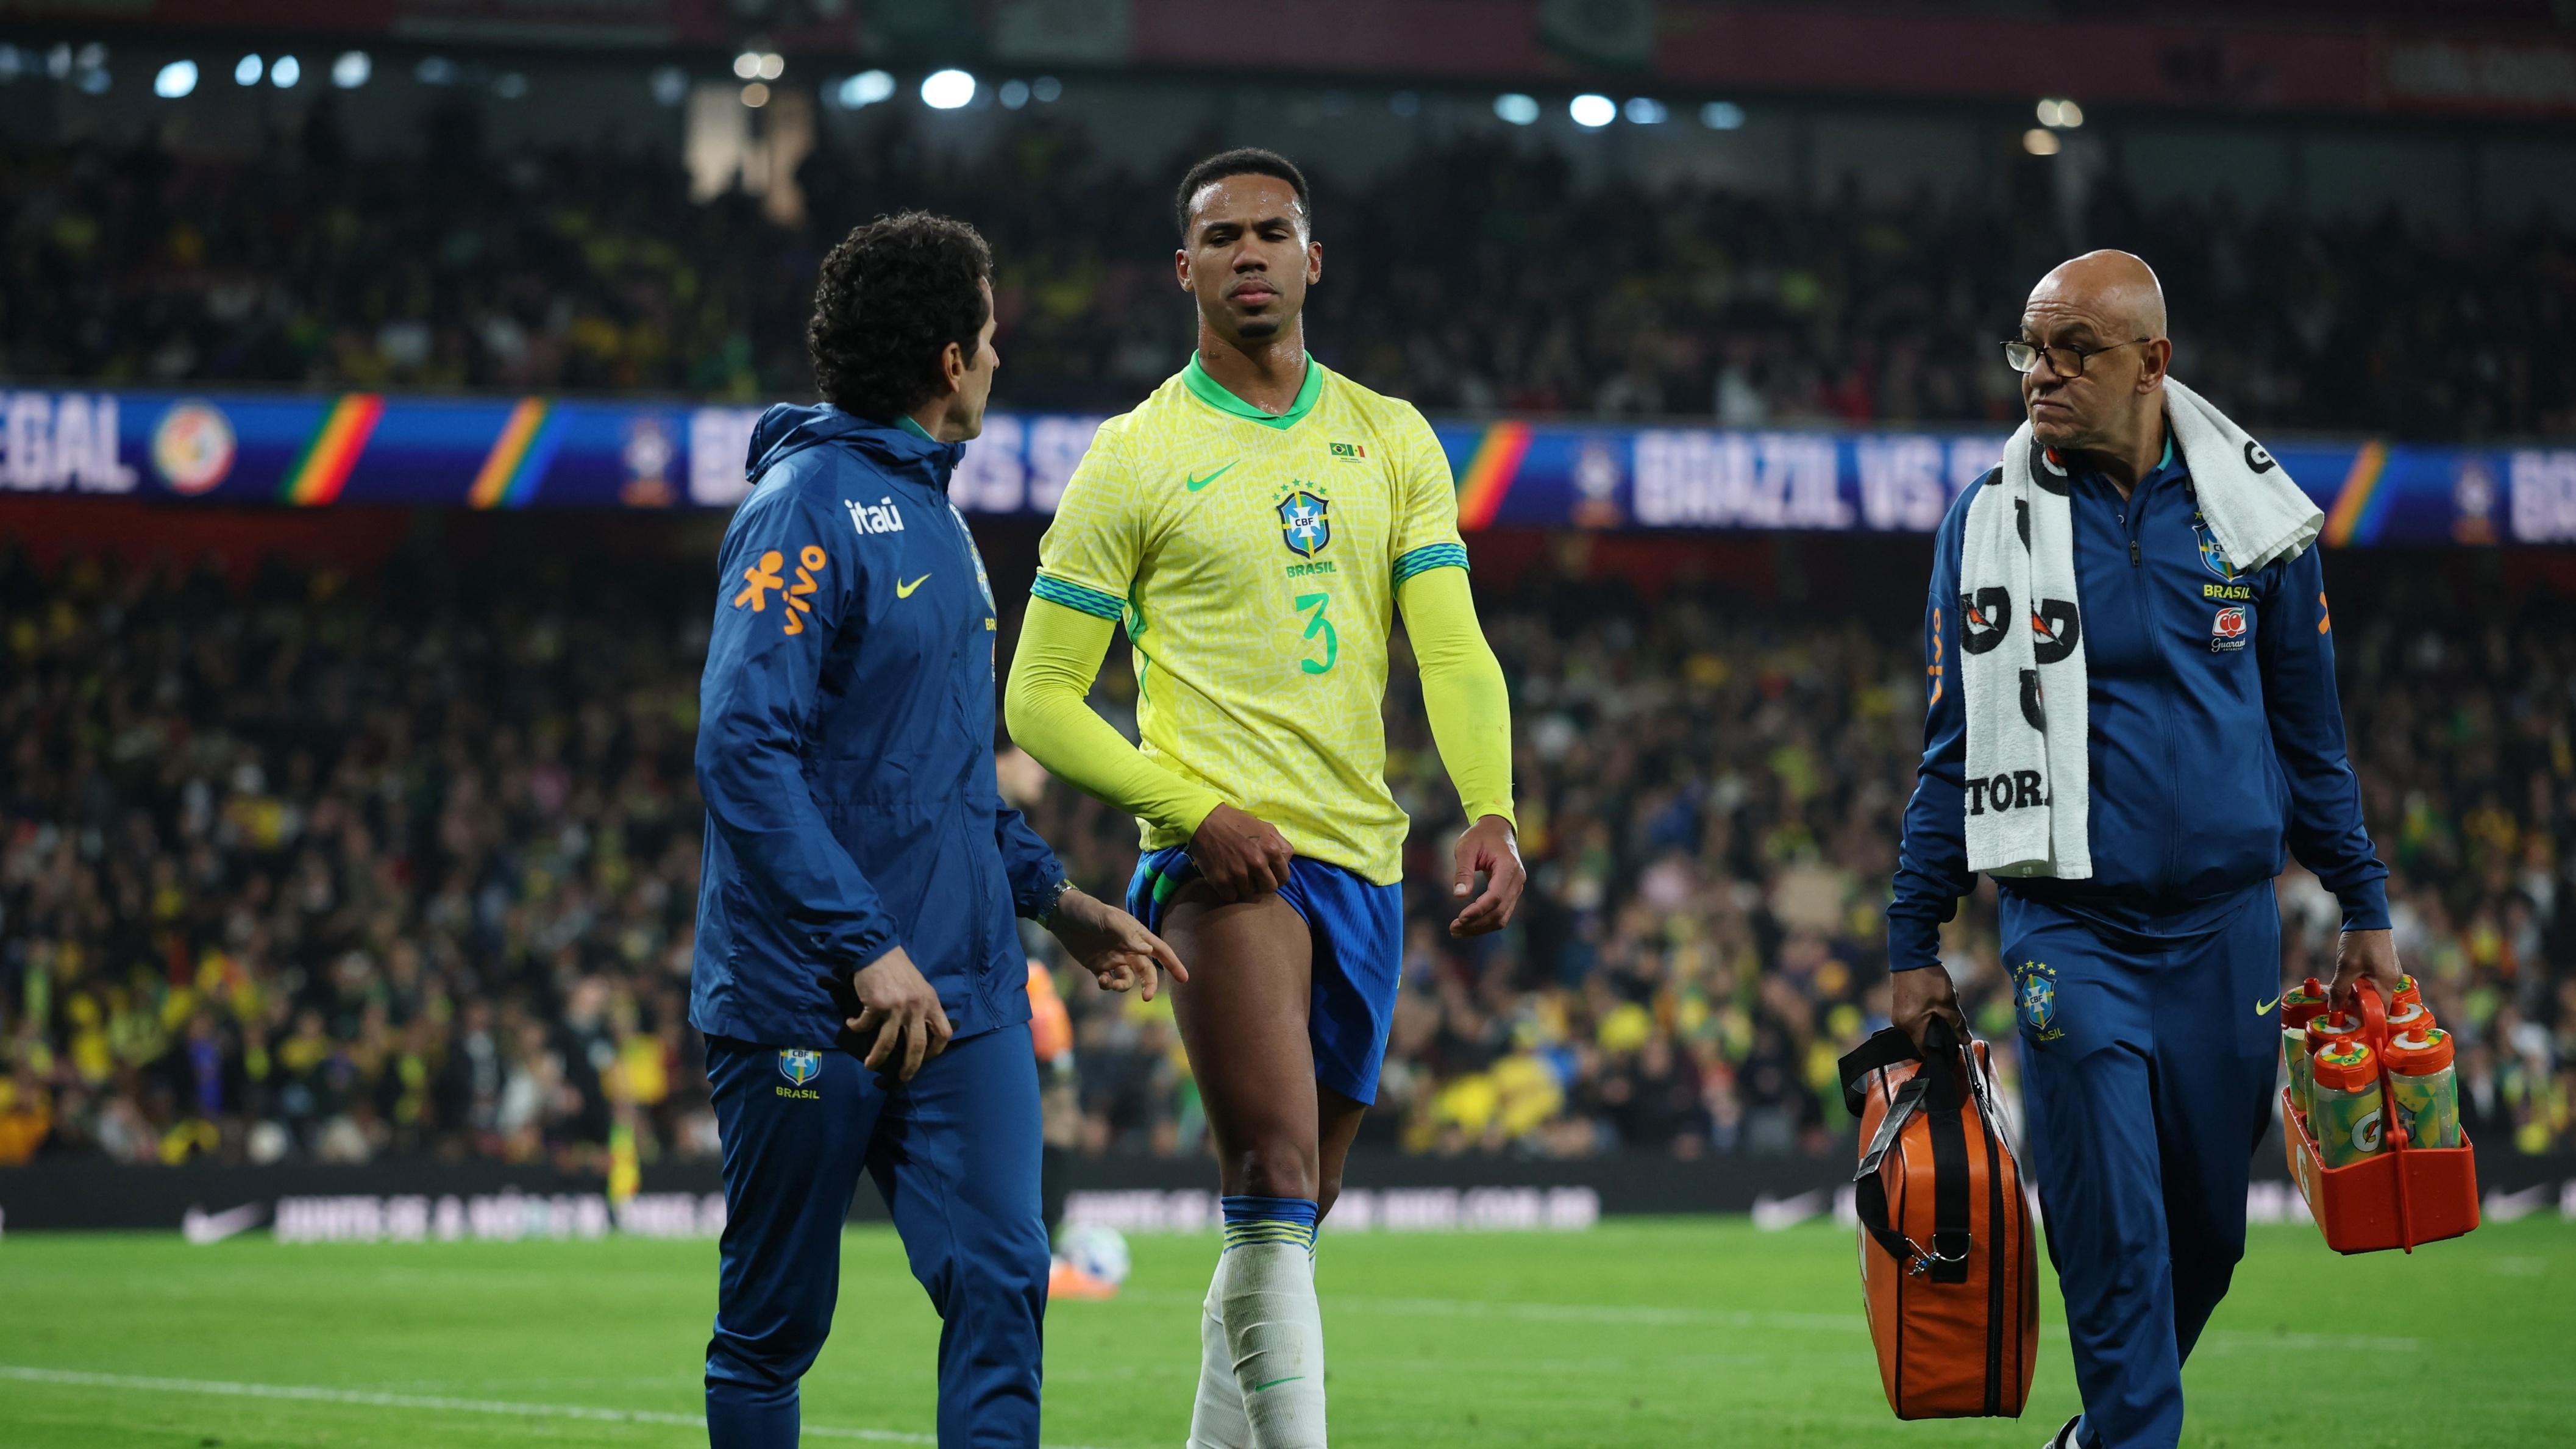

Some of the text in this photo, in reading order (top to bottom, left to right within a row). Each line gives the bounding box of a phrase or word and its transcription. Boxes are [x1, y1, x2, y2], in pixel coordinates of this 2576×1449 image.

[1634, 430, 1854, 528] BRAZIL
[1857, 435, 1944, 530] VS
[845, 496, 905, 535] itaú
[1295, 517, 1314, 527] CBF
[1286, 561, 1337, 578] BRASIL
[782, 545, 827, 635] vivo
[2204, 585, 2251, 599] BRASIL
[1295, 592, 1338, 674] 3
[2030, 995, 2043, 1003] CBF
[776, 1086, 820, 1099] BRASIL
